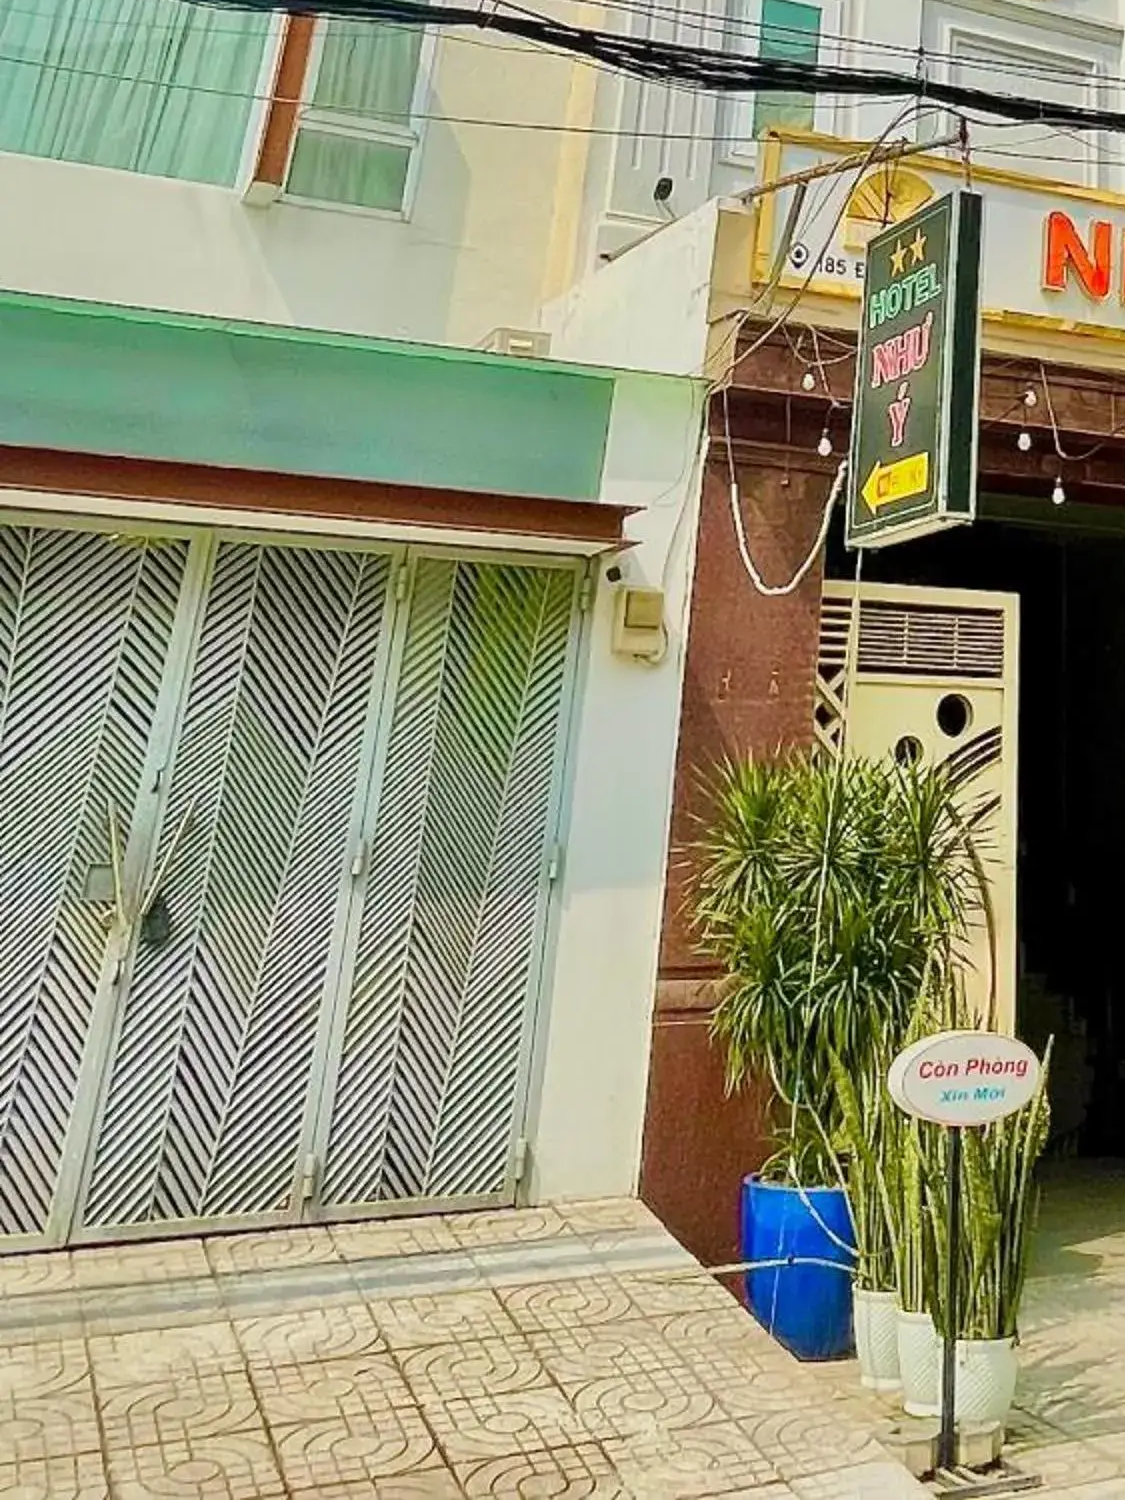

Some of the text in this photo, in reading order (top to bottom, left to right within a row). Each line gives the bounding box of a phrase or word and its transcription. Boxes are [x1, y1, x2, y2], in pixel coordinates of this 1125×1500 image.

[869, 263, 942, 329] HOTEL
[871, 311, 933, 389] NHƯ
[888, 381, 911, 447] Ý
[919, 1057, 1028, 1079] Còn Phòng
[941, 1088, 968, 1102] Xin
